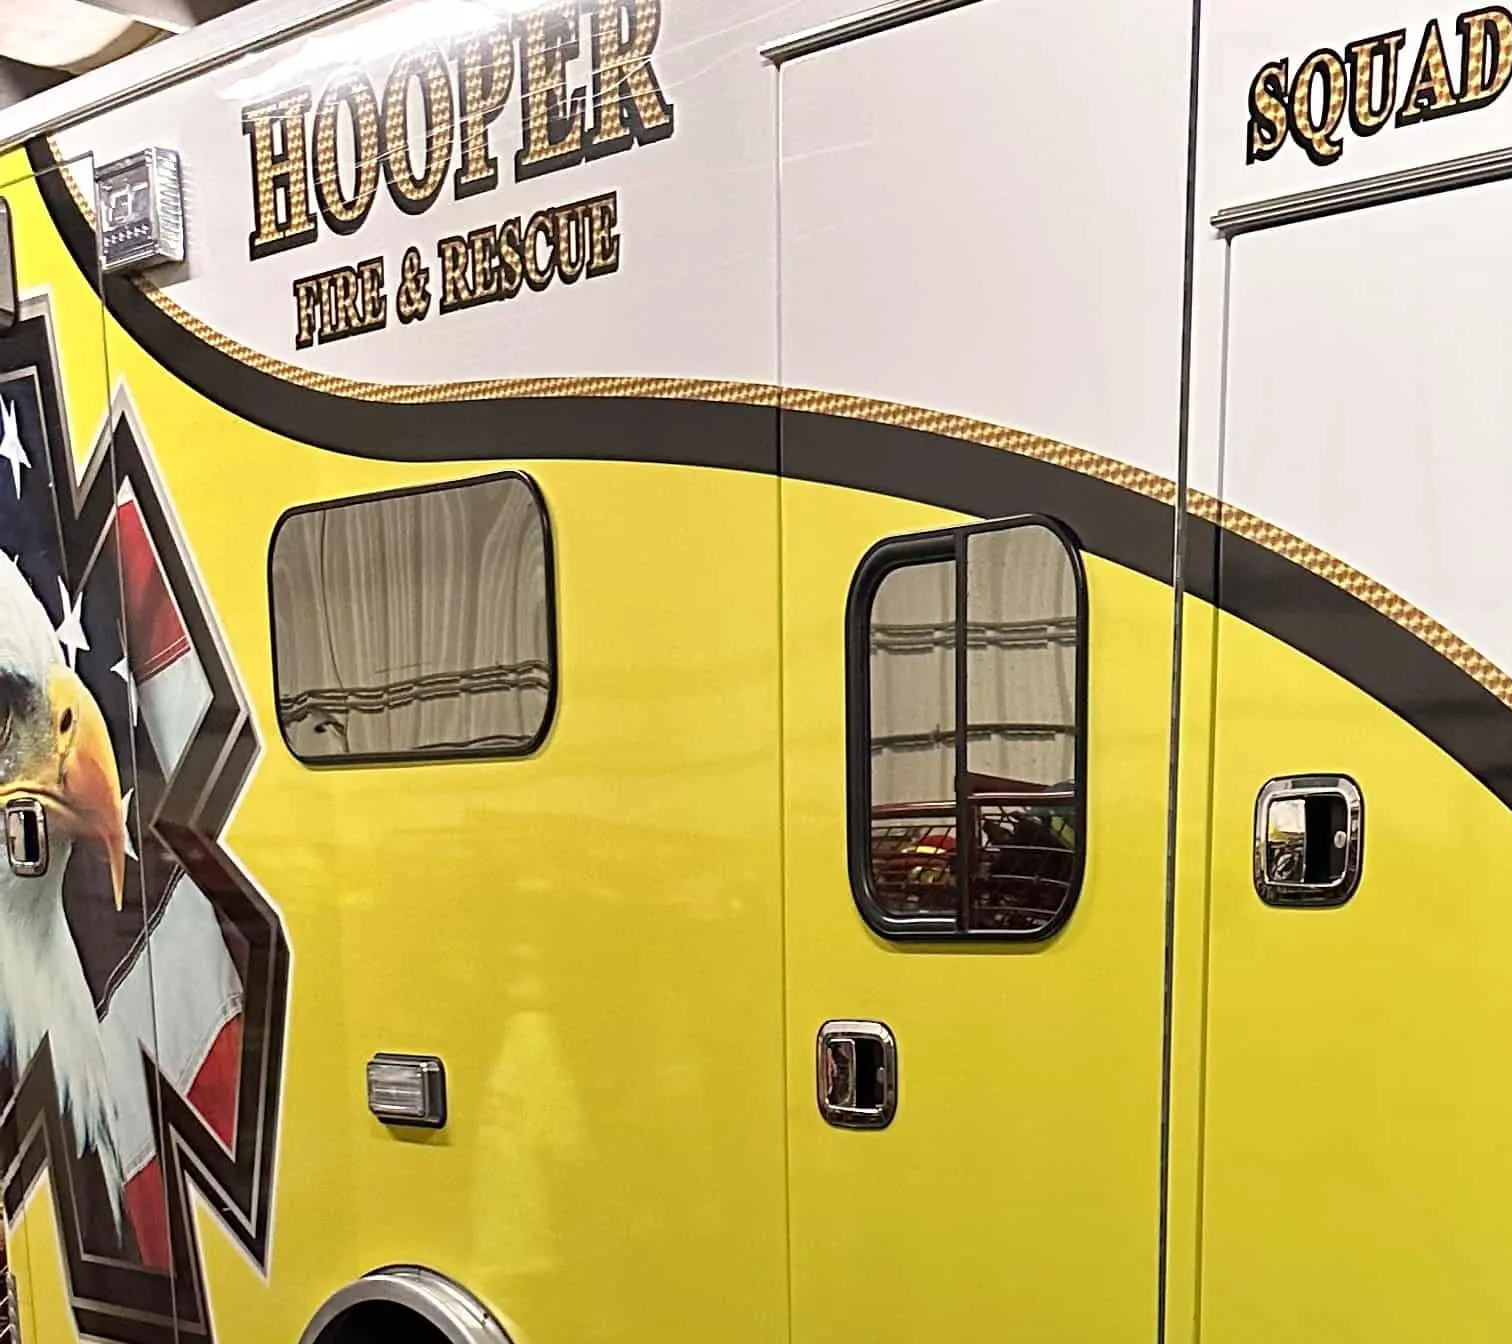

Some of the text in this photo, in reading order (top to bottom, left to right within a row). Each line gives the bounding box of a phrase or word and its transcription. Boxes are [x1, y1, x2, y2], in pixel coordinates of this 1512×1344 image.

[241, 0, 675, 261] HOOPER
[293, 191, 619, 350] FIRE & RESCUE
